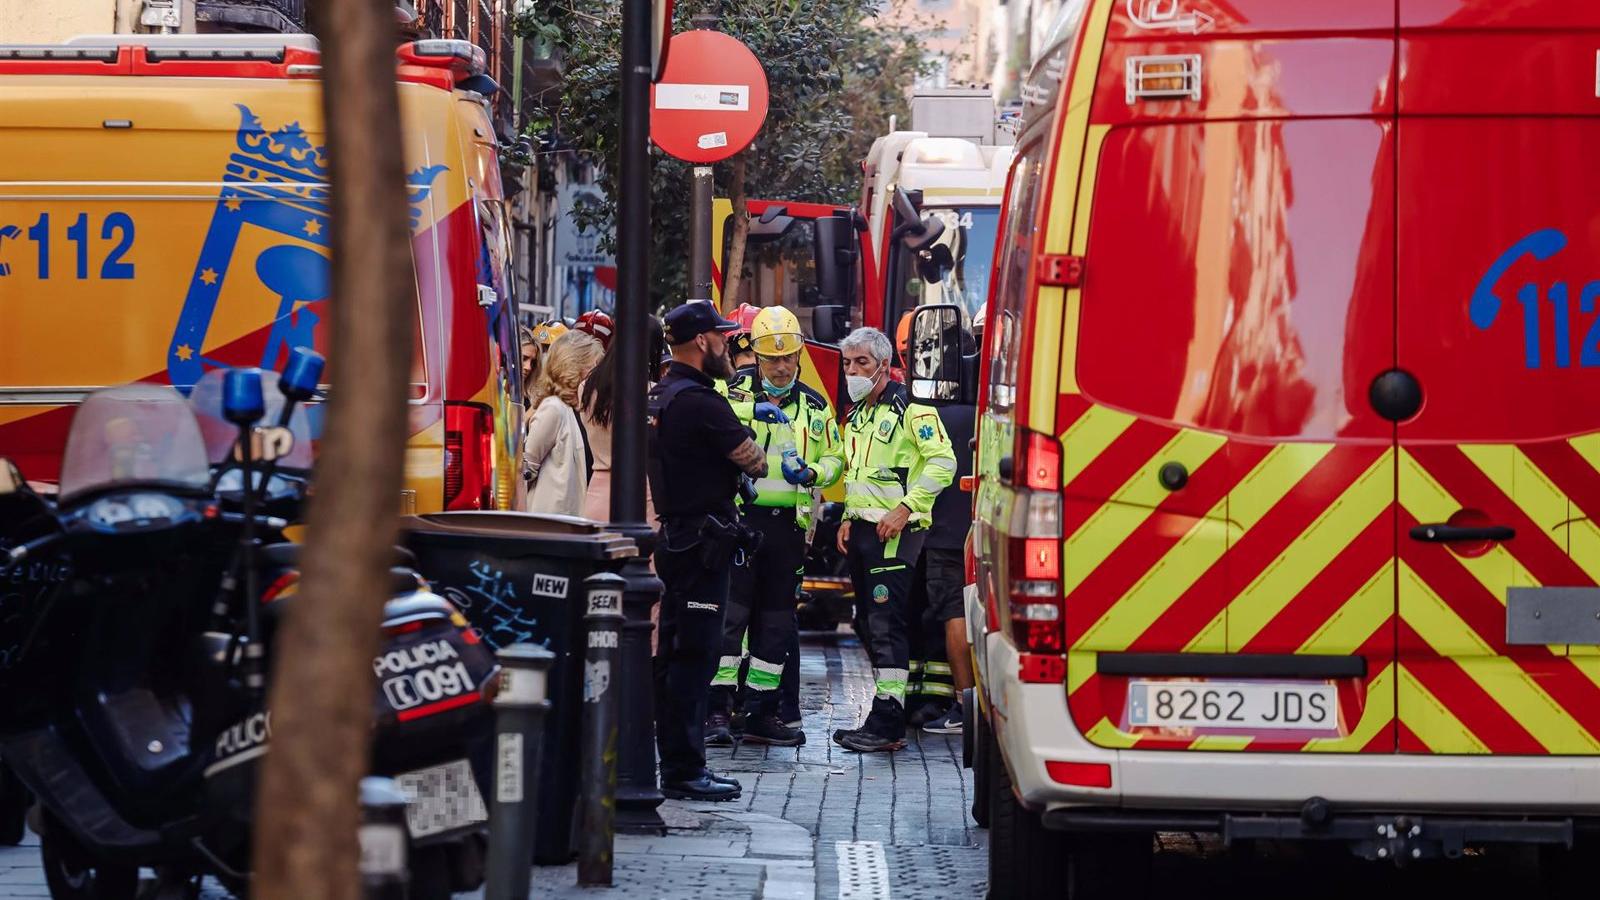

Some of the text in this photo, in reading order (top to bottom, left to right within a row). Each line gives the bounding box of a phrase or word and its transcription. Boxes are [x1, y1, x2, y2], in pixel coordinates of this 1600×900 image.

[28, 211, 135, 280] 112
[1517, 279, 1600, 368] 112
[535, 577, 567, 595] NEW
[372, 639, 459, 678] POLICIA
[414, 662, 475, 701] 091
[1155, 689, 1327, 723] 8262 JDS
